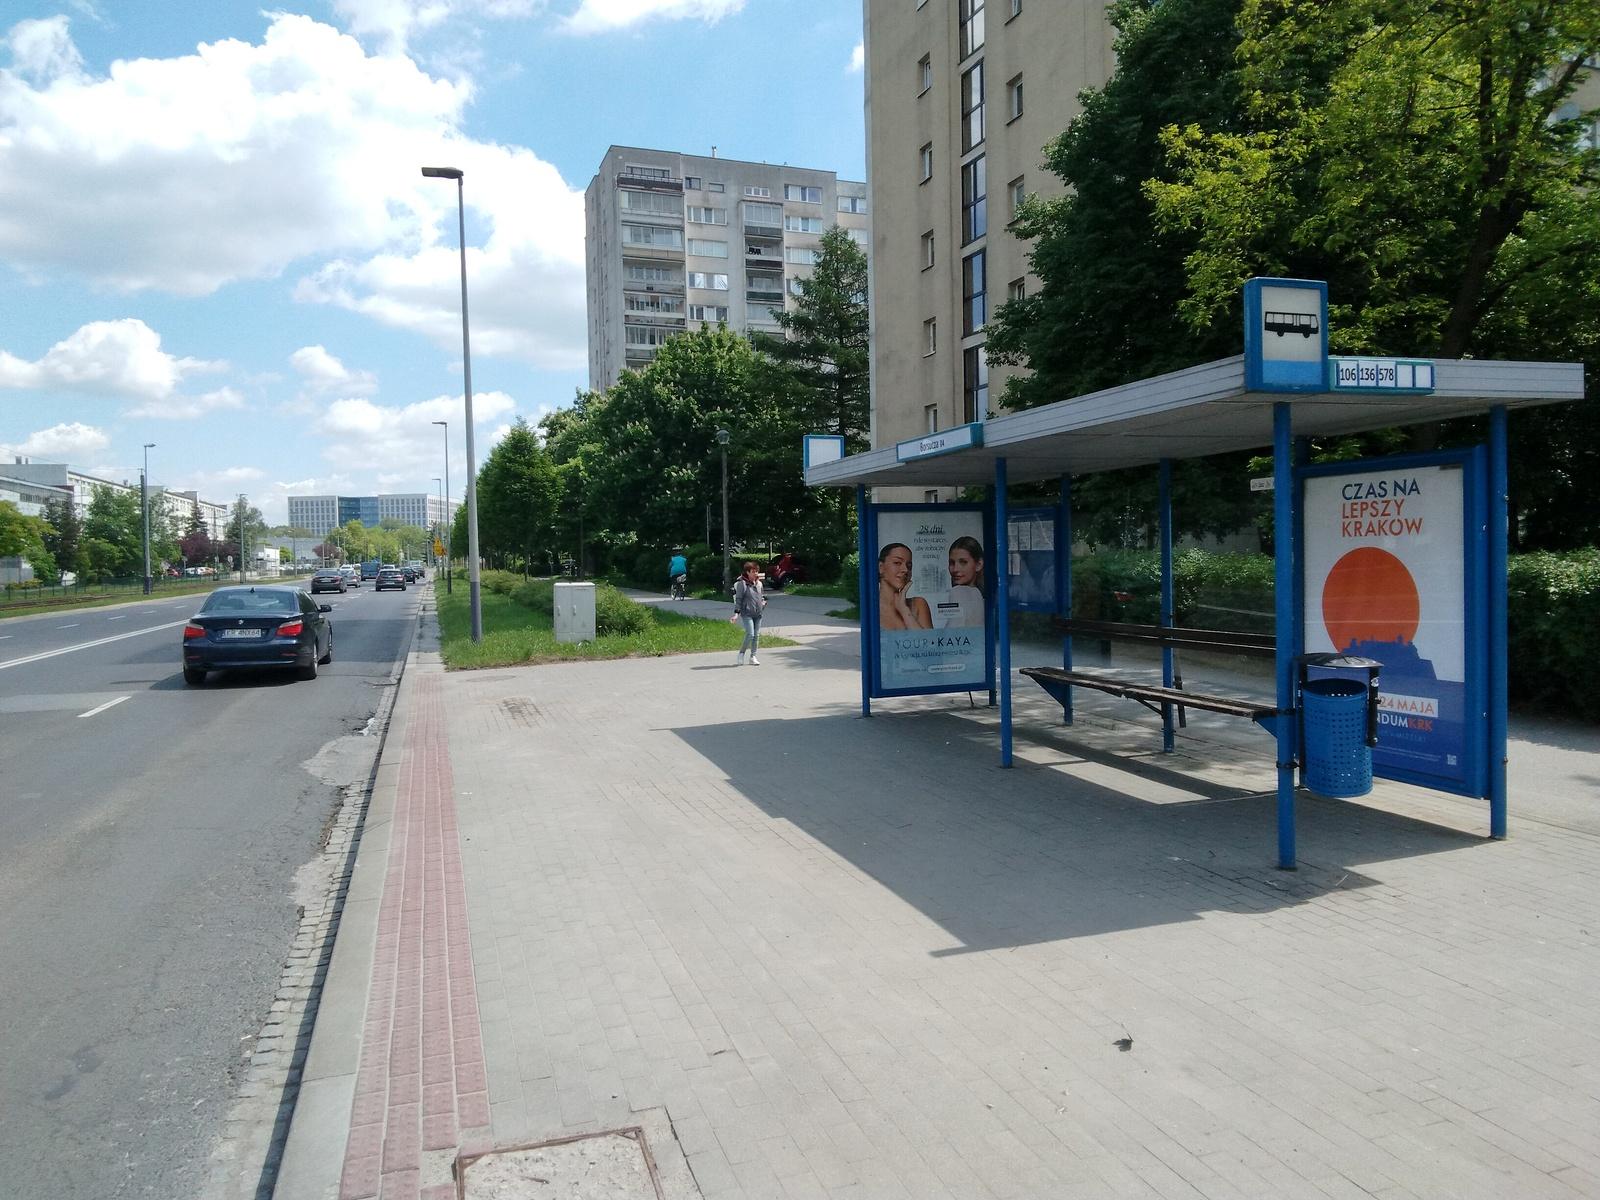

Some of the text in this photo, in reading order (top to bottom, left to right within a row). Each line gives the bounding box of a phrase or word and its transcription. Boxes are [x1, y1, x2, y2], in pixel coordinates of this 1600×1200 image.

[1340, 367, 1395, 381] 106 136 578
[1341, 477, 1422, 501] CZAS NA
[1342, 498, 1405, 519] LEPSZY
[937, 636, 971, 647] KAYA
[1379, 695, 1435, 715] 24 MAJA
